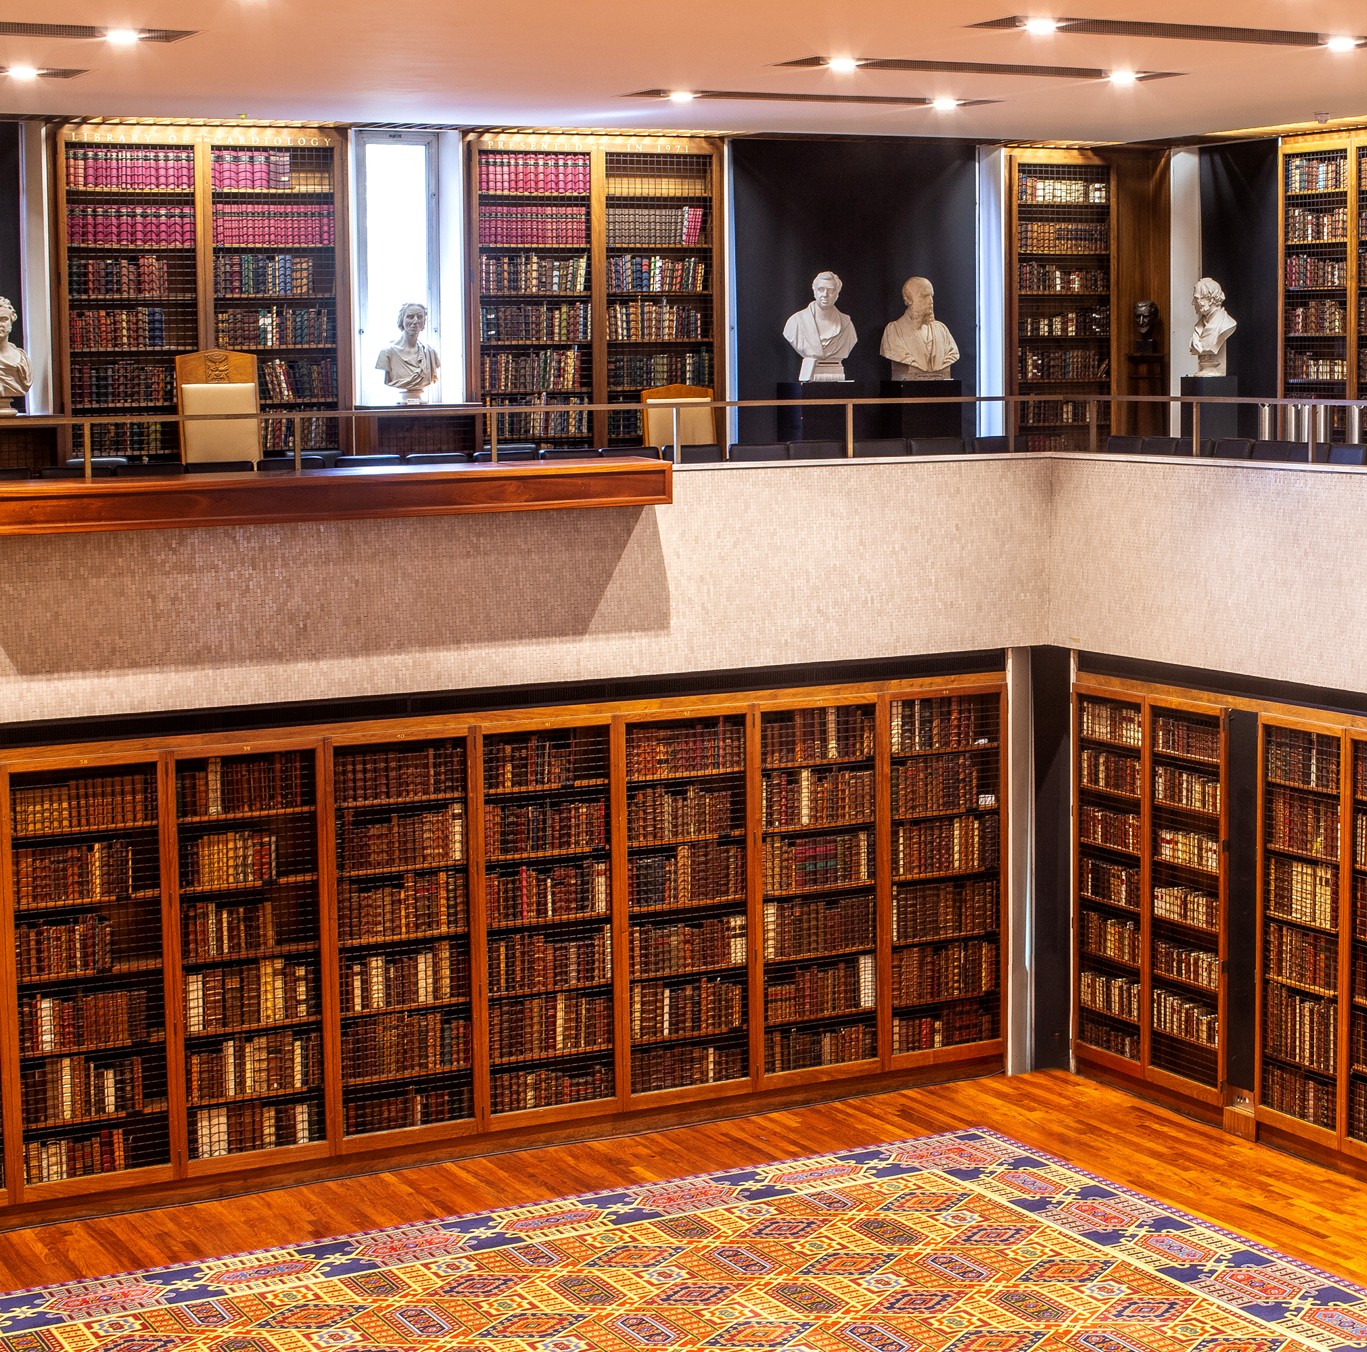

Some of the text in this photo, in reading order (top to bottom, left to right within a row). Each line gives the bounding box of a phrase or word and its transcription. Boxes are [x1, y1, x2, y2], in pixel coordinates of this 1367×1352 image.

[71, 132, 332, 146] LIBRARY OF CARDIOLOGY
[488, 141, 689, 153] PRESENTED IN 1971
